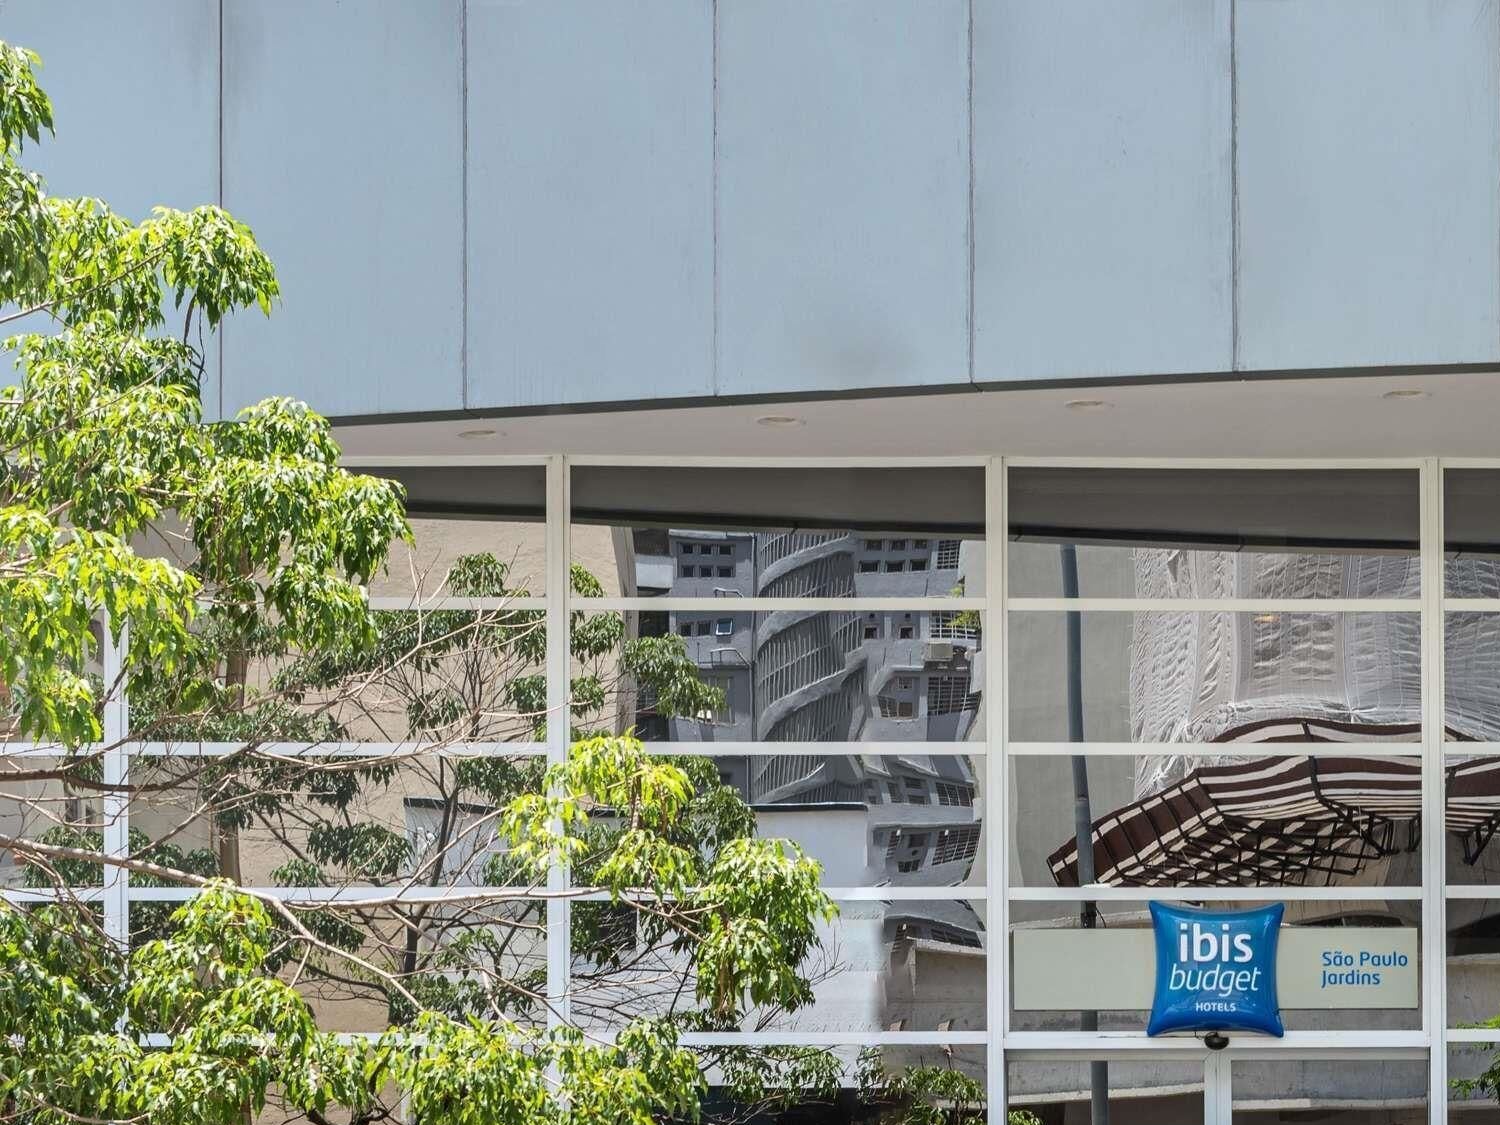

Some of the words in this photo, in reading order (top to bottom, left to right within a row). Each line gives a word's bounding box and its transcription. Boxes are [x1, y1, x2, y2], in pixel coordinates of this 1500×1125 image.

[1180, 923, 1253, 962] ibis
[1322, 951, 1353, 966] São
[1360, 951, 1408, 967] Paulo
[1169, 963, 1261, 997] budget
[1321, 970, 1380, 988] Jardins
[1195, 1002, 1237, 1012] HOTELS
